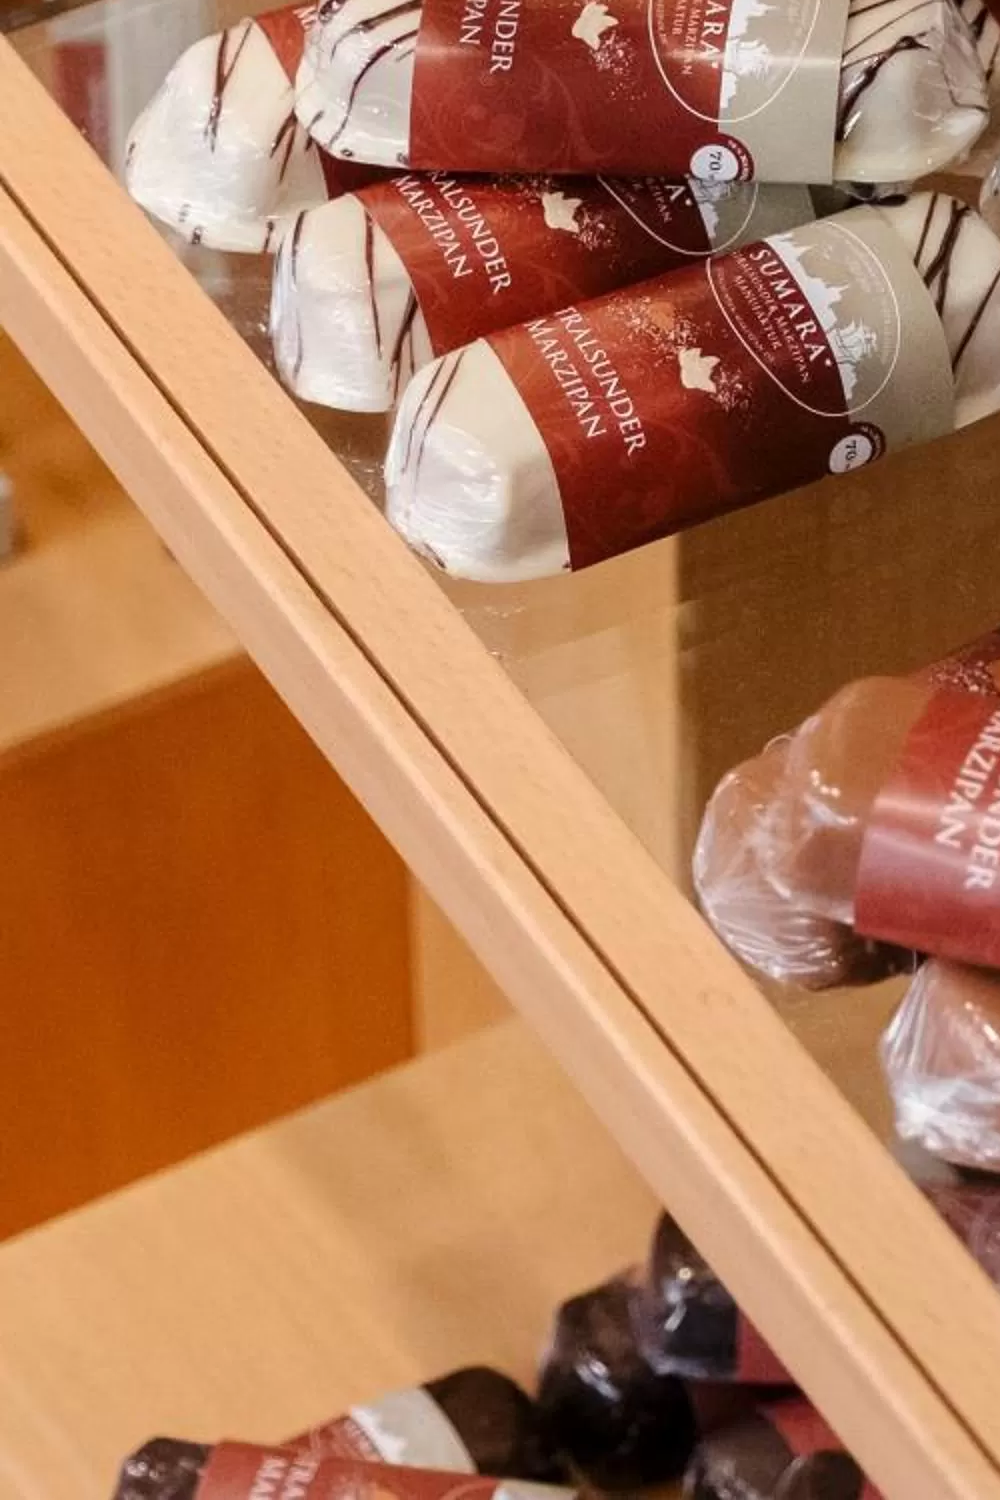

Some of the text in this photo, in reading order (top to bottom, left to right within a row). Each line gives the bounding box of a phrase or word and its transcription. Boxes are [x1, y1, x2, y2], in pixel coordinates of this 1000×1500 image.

[709, 151, 722, 171] 70
[391, 175, 473, 278] MARZIPAN
[426, 169, 513, 296] RALSUNDER
[750, 249, 826, 362] SUMARA
[522, 318, 608, 439] MARZIPAN
[554, 305, 647, 457] TRALSUNDER
